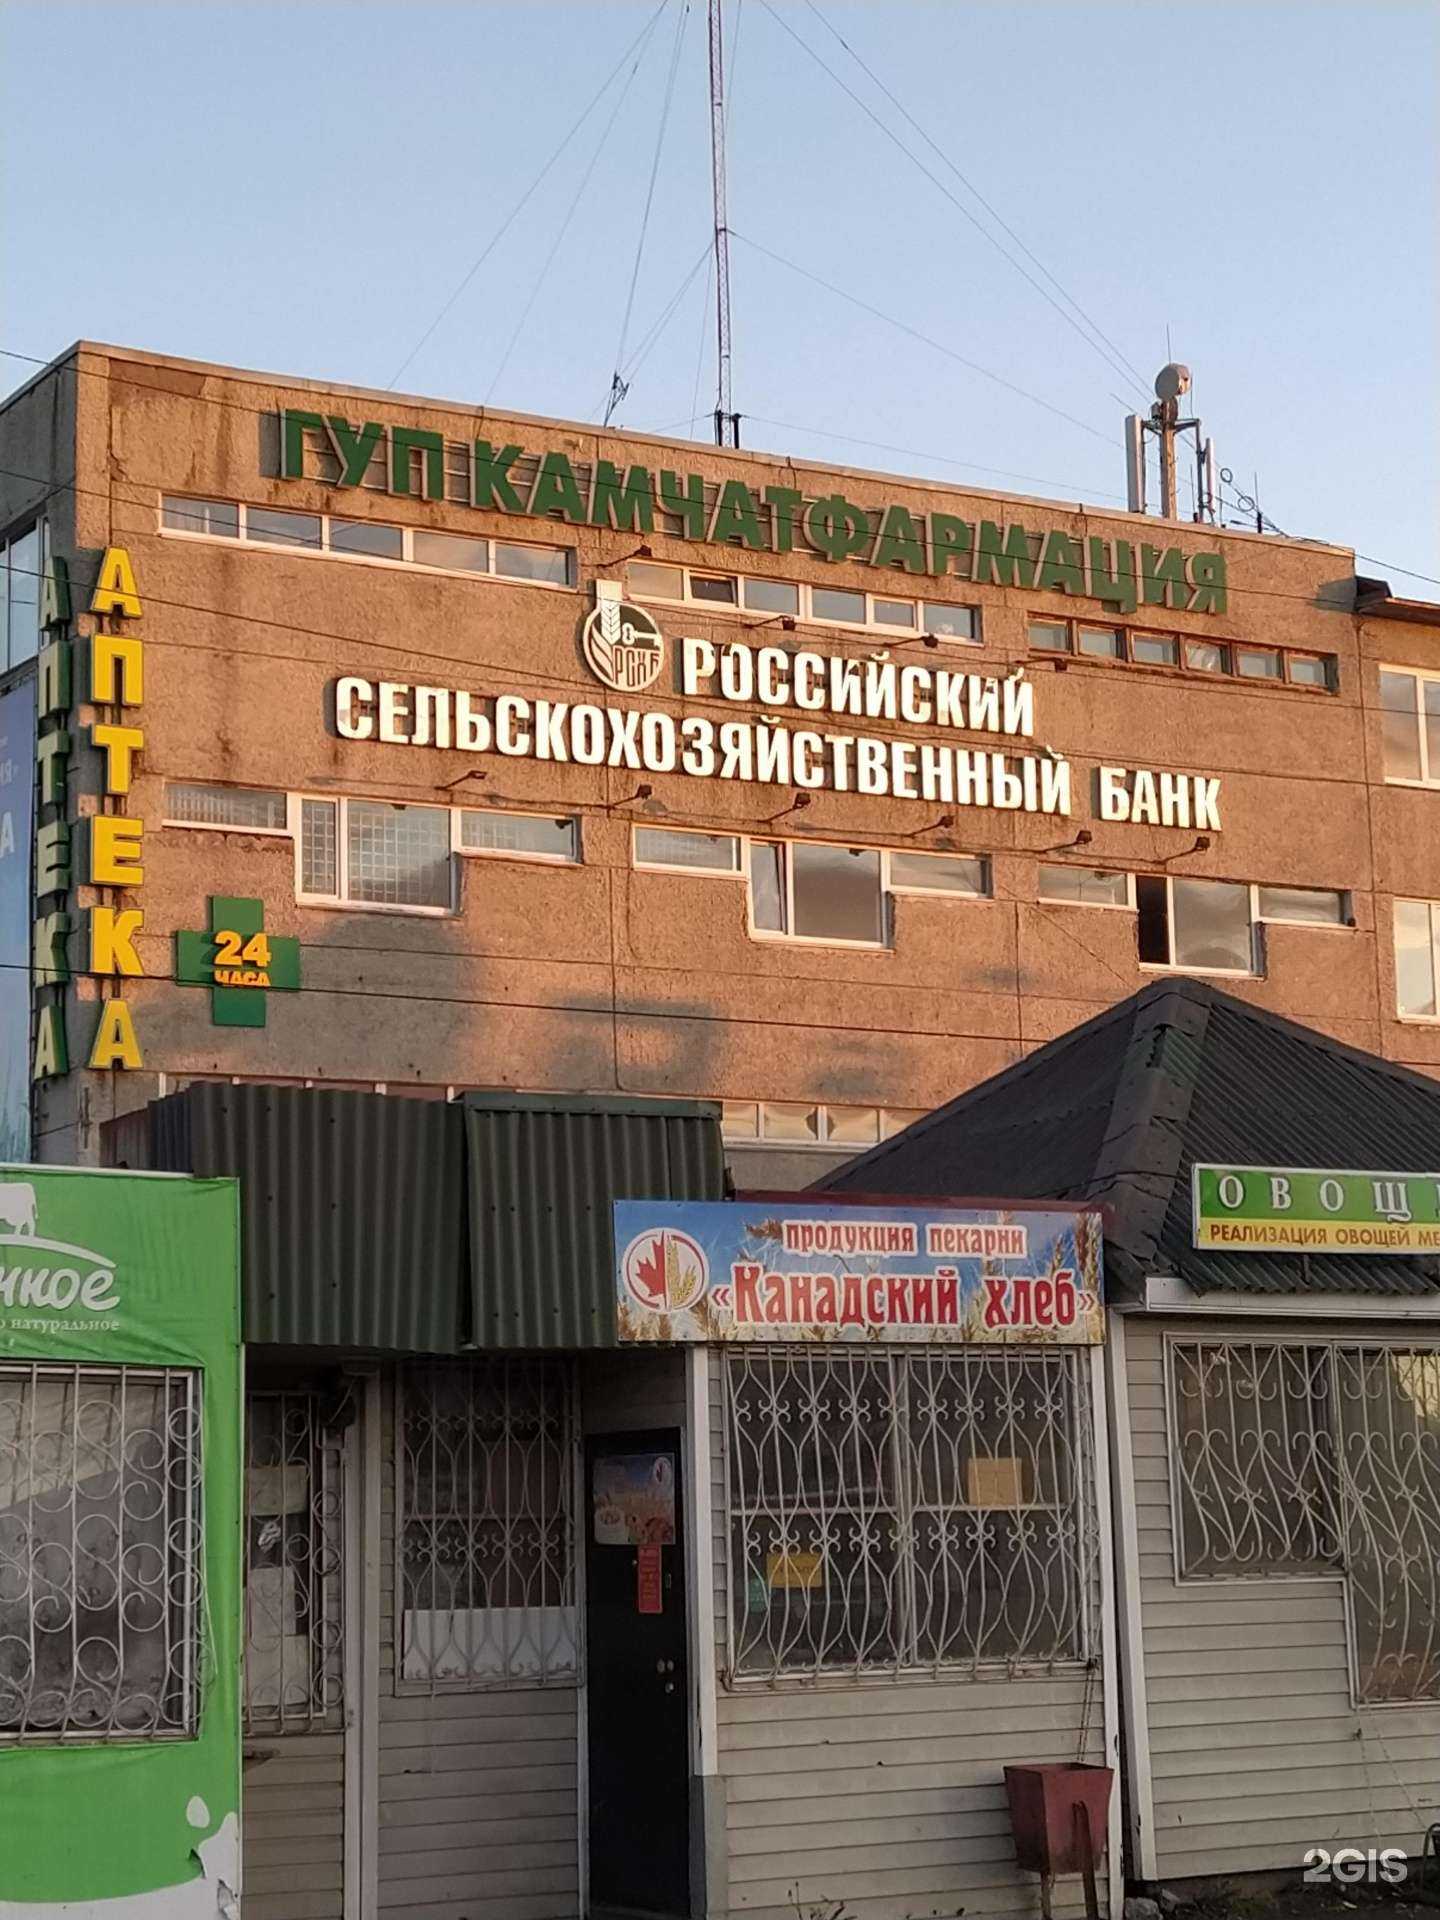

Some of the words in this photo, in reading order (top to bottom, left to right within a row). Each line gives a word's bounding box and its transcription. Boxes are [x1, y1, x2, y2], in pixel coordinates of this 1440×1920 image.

[281, 409, 445, 501] ГУП
[470, 436, 1227, 615] КАМЧАТФАРМАЦИЯ
[682, 636, 1034, 737] РОССИЙСКИЙ
[336, 676, 1072, 817] СЕЛЬСКОХОЗЯЙСТВЕННЫЙ
[1098, 766, 1222, 833] БАНК
[33, 555, 72, 1081] АПТЕКА
[89, 546, 144, 1070] АПТЕКА
[214, 930, 271, 967] 24
[1210, 1224, 1328, 1245] РЕАЛИЗАЦИЯ
[1336, 1227, 1410, 1247] ОВОЩЕЙ
[1219, 1175, 1440, 1221] ОВОЩ
[11, 1319, 120, 1335] натуральное
